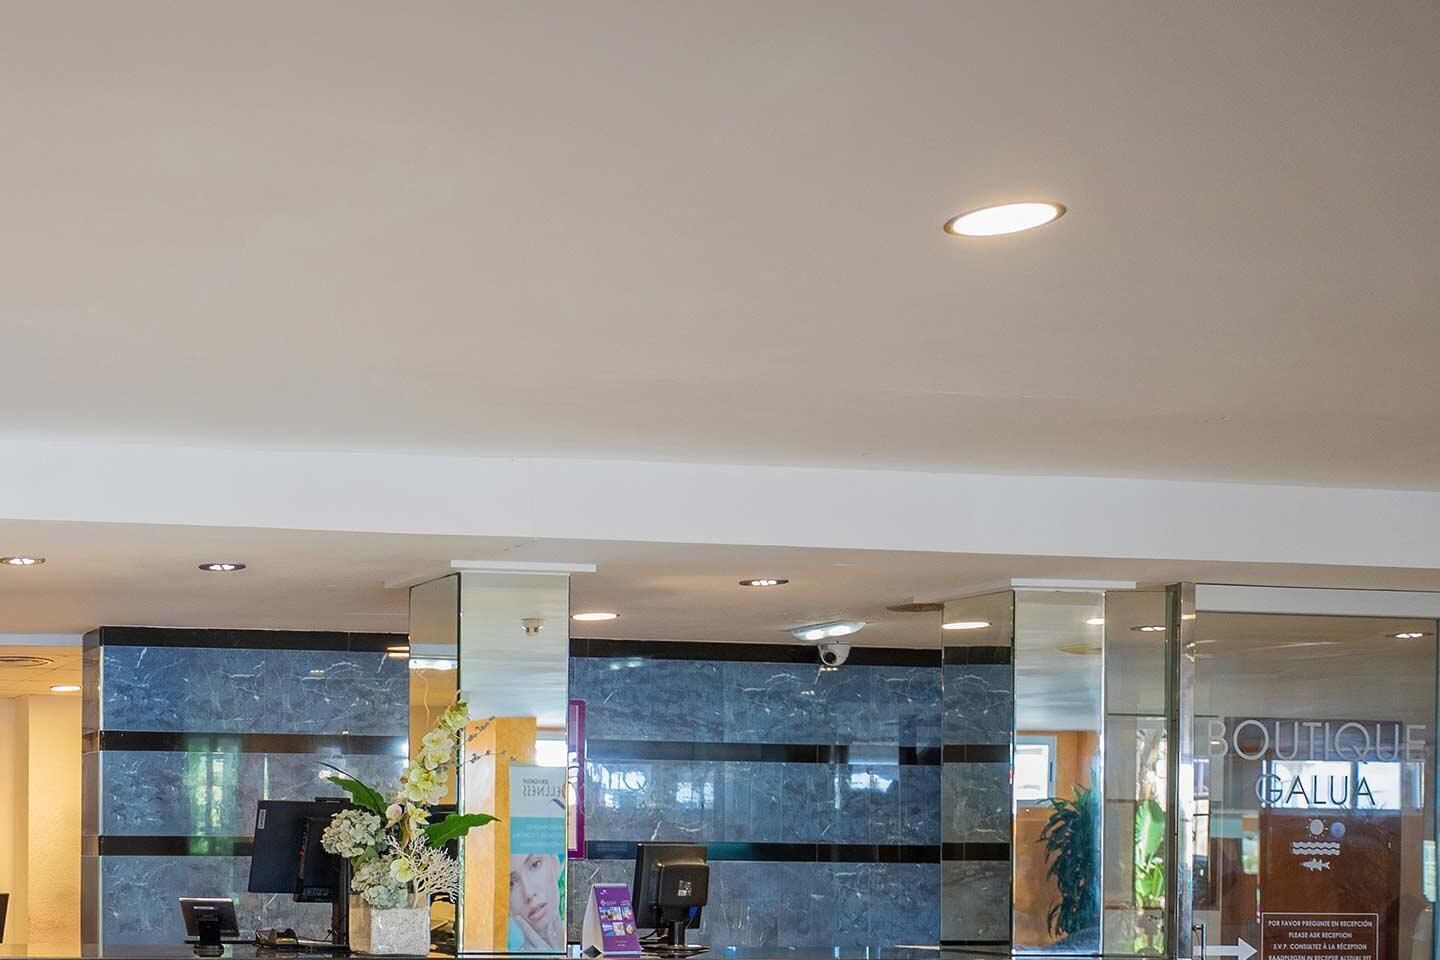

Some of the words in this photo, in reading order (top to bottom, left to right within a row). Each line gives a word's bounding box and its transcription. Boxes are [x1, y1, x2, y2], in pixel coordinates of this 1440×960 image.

[1208, 719, 1427, 764] BOUTIQUE
[1255, 773, 1376, 806] GALUA
[1340, 919, 1373, 928] RECEPCIÓN
